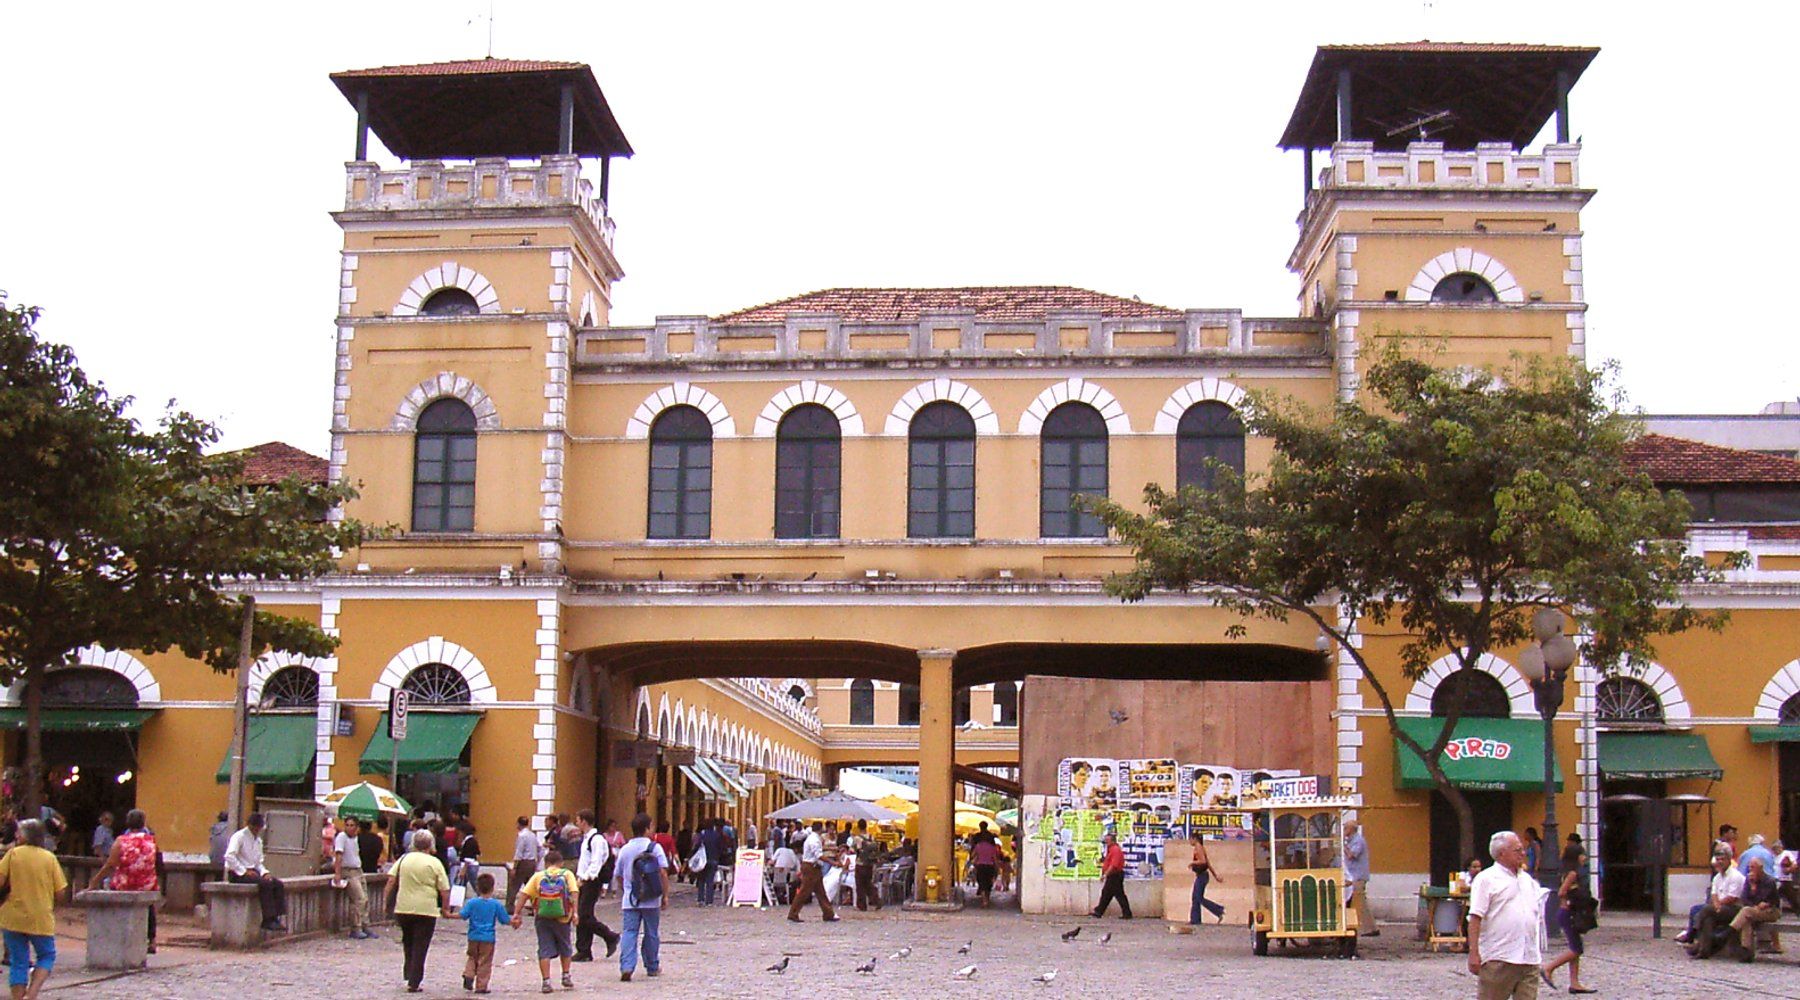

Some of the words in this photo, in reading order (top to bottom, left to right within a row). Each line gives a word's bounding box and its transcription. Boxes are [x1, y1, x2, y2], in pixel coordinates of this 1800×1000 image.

[1132, 785, 1175, 793] PETRY
[1268, 781, 1296, 797] ARKET
[1298, 779, 1316, 796] DOG
[1459, 781, 1506, 790] restaurante
[1191, 815, 1218, 826] FESTA
